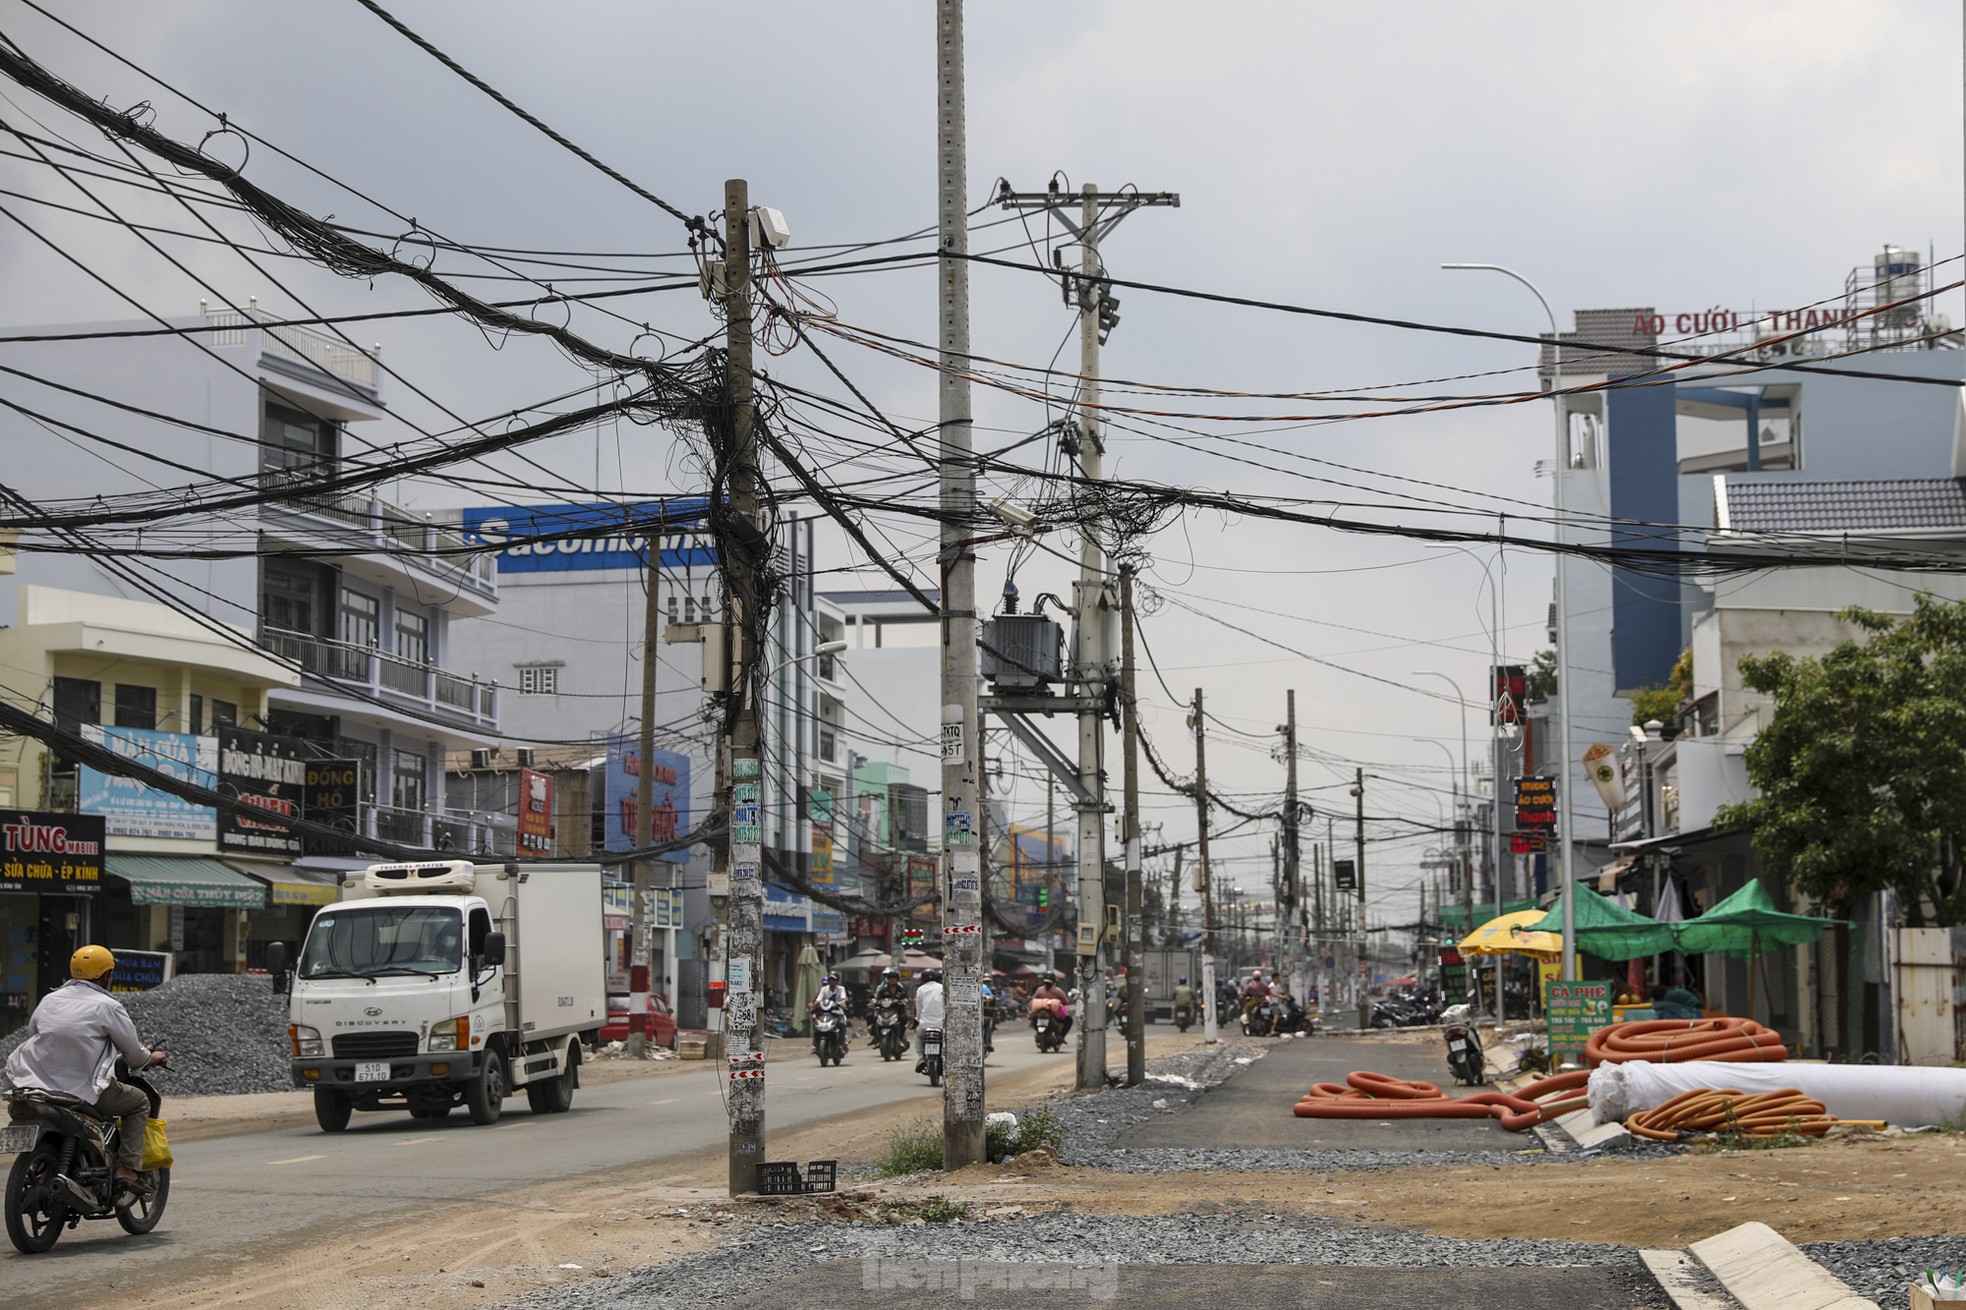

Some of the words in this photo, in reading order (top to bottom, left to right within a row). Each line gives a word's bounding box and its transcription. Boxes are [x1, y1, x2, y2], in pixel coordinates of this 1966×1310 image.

[1676, 305, 1738, 334] CƯỚI
[306, 764, 355, 786] ĐỒNG
[3, 816, 67, 853] TÙNG
[1574, 986, 1607, 998] PHÊ
[365, 1064, 381, 1072] 51D
[359, 1073, 386, 1081] 671.10
